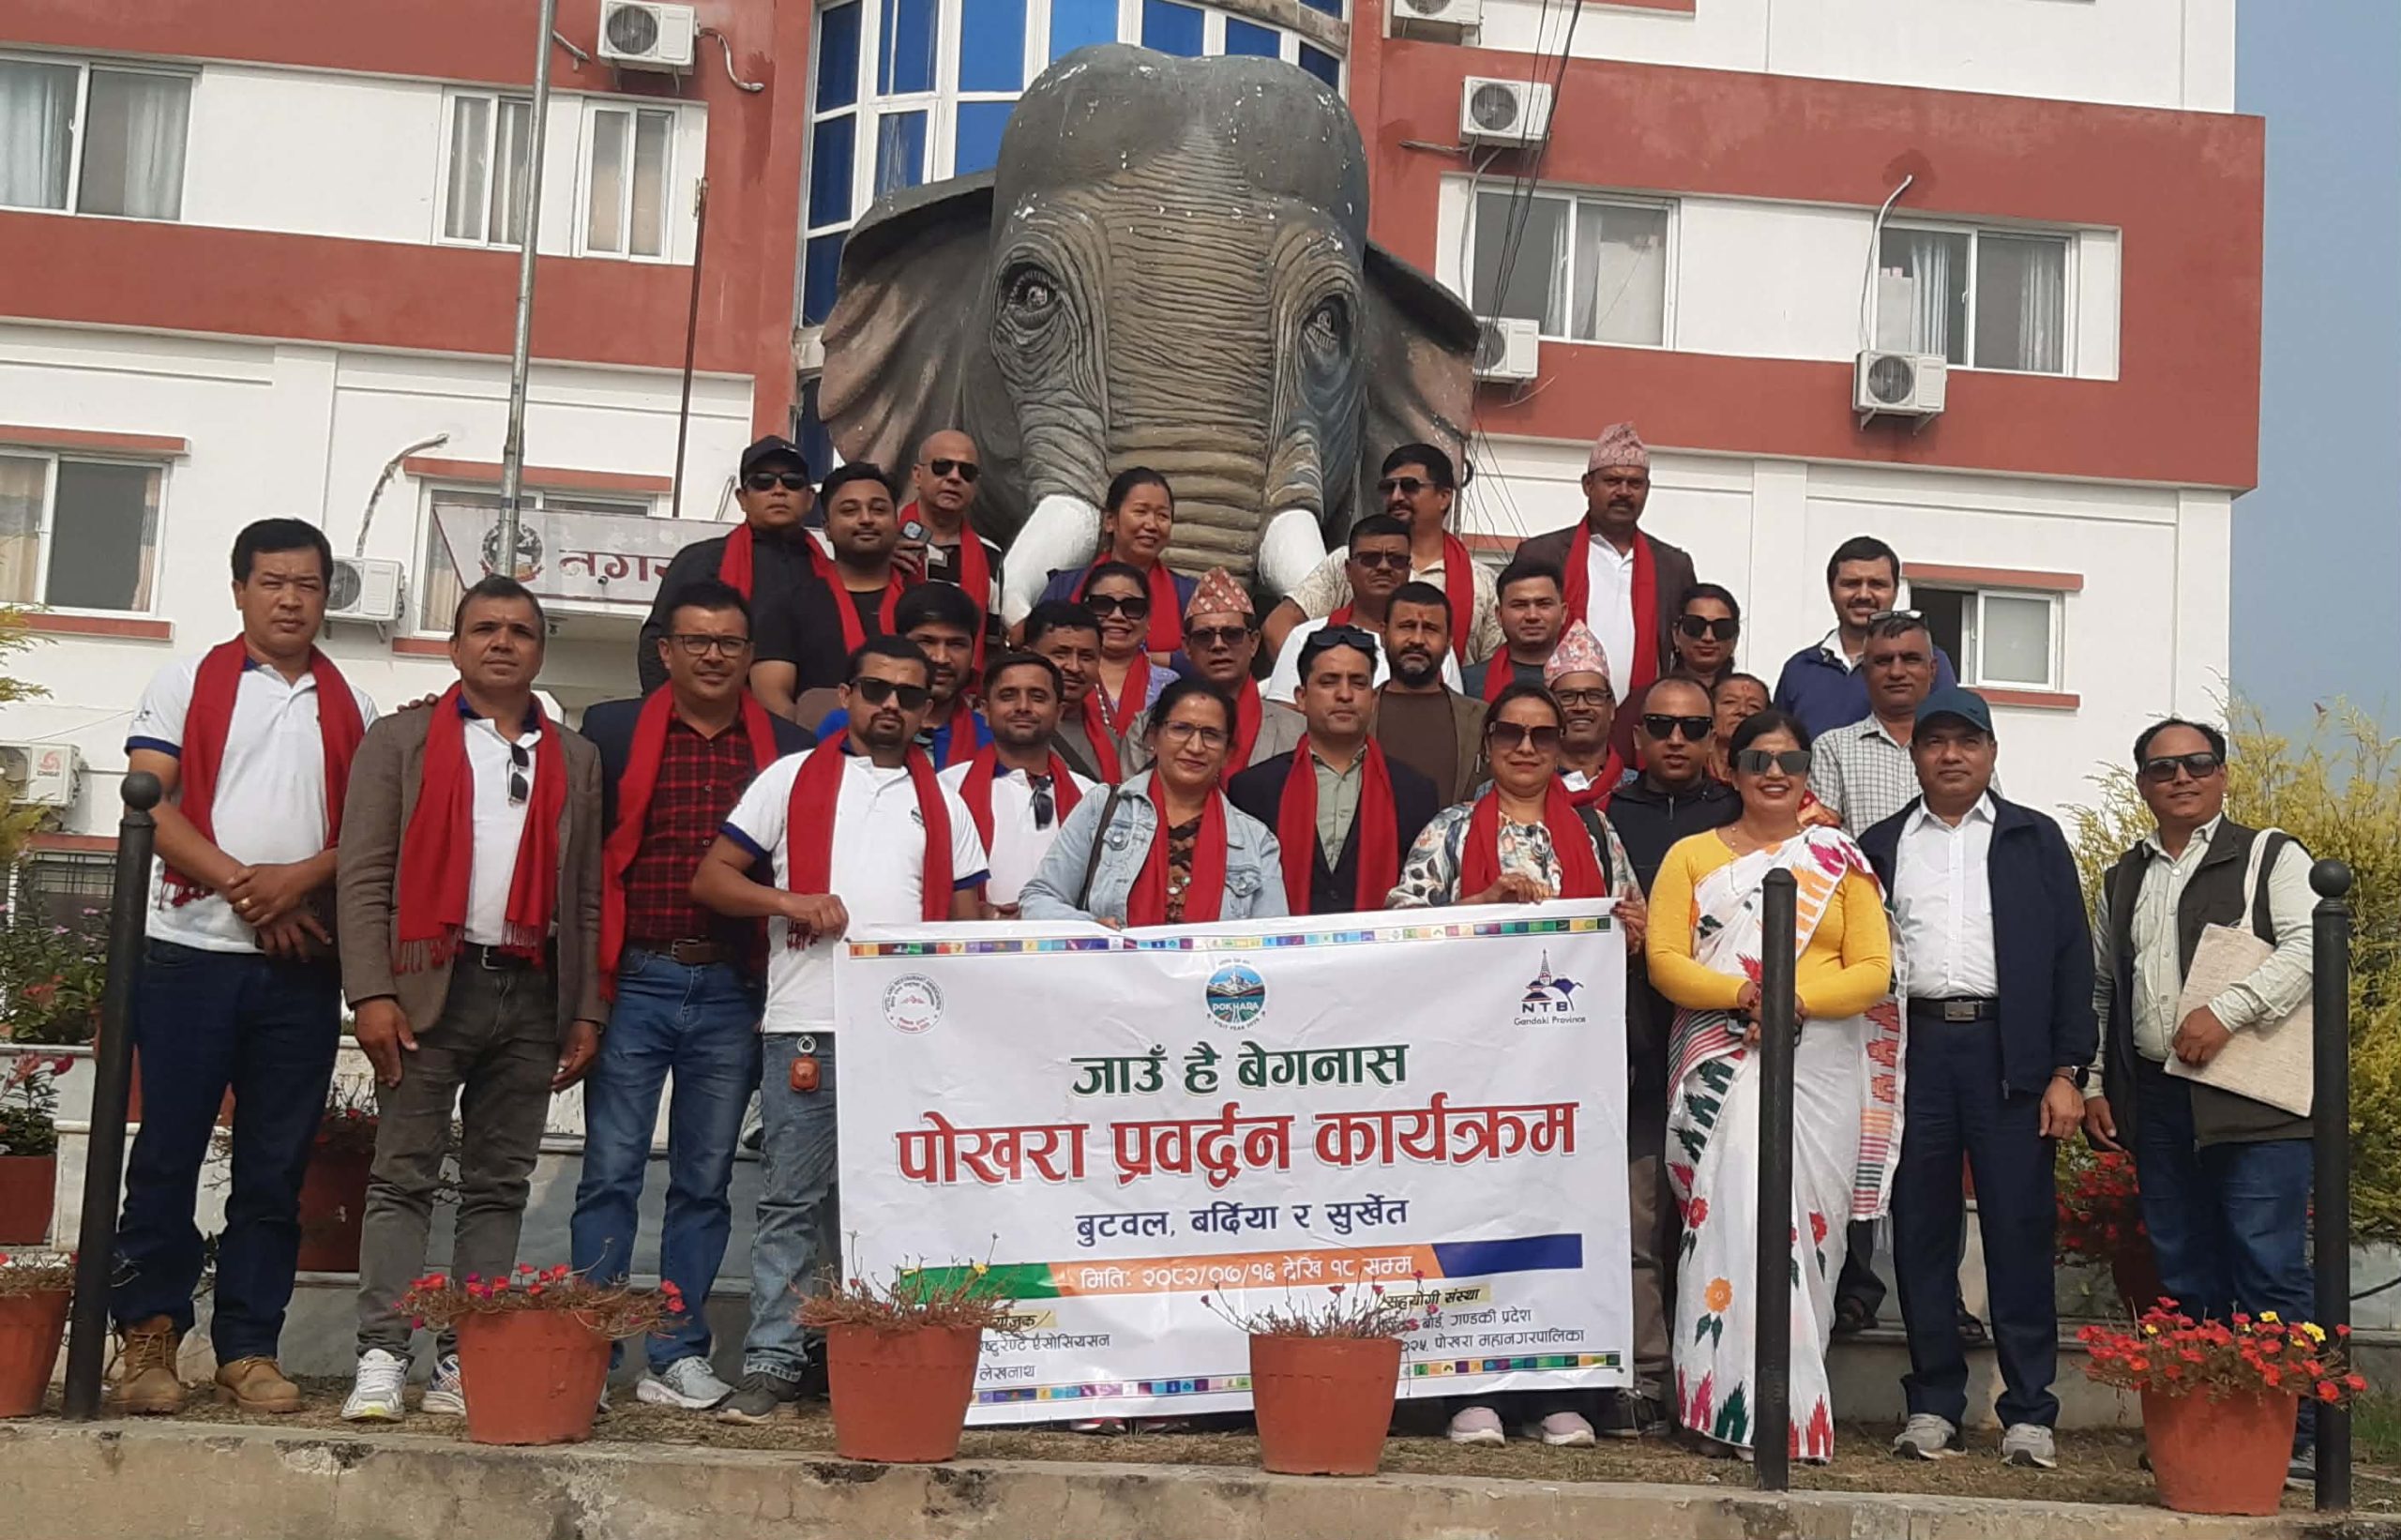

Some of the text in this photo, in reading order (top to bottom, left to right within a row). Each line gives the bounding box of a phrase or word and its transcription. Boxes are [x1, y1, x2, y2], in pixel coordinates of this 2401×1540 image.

[1212, 1002, 1260, 1013] POKHARA
[1522, 1002, 1568, 1013] NTB
[1514, 1015, 1586, 1025] Gandaki Province
[1070, 1041, 1410, 1094] जाउँ है बेगनास
[895, 1110, 1091, 1185] पोखरा
[1314, 1091, 1580, 1166] कार्यक्रम
[1074, 1194, 1411, 1247] बुटवल, बर्दिया र सुर्खेत
[1080, 1255, 1412, 1290] मिति: २०८२/०७/१६ देखि १८ सम्म
[1444, 1287, 1481, 1304] संस्था
[1450, 1309, 1497, 1326] गण्डकी
[1502, 1306, 1532, 1324] प्रदेश
[1435, 1332, 1473, 1350] पोखरा
[1479, 1327, 1585, 1348] महानगरपालिका
[979, 1363, 1036, 1381] लेखनाथ
